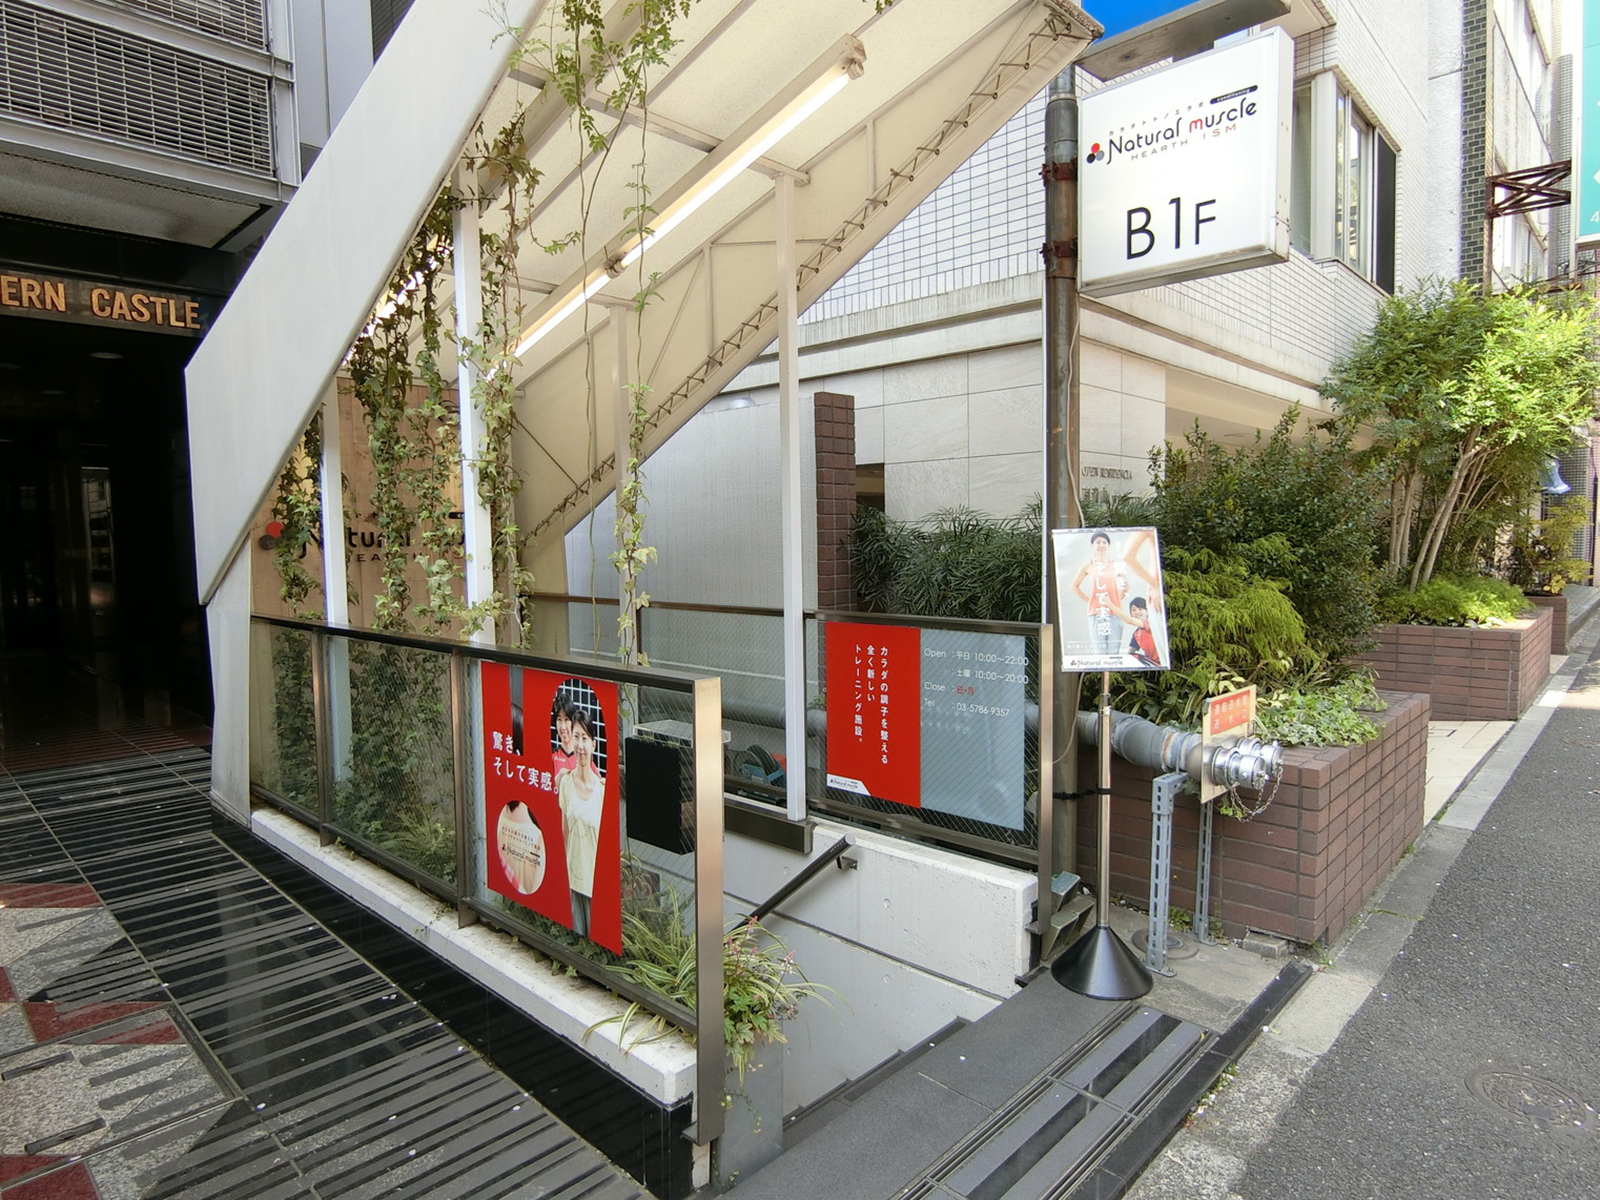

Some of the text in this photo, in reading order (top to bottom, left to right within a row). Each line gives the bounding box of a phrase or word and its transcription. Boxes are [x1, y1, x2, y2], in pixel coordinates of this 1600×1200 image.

[1106, 97, 1258, 165] Natural muscle
[1130, 123, 1238, 161] HEARTH ISM
[1126, 196, 1217, 260] B1F
[0, 275, 201, 329] ERN CASTLE
[867, 645, 876, 702] 全く新しい
[923, 647, 946, 659] Open
[854, 643, 863, 743] トレーニング施設。
[880, 646, 889, 764] カラダの調子を整える
[923, 681, 946, 692] Close
[923, 698, 936, 707] Tel
[492, 730, 522, 757] 驚き、
[493, 756, 559, 795] そして実感。
